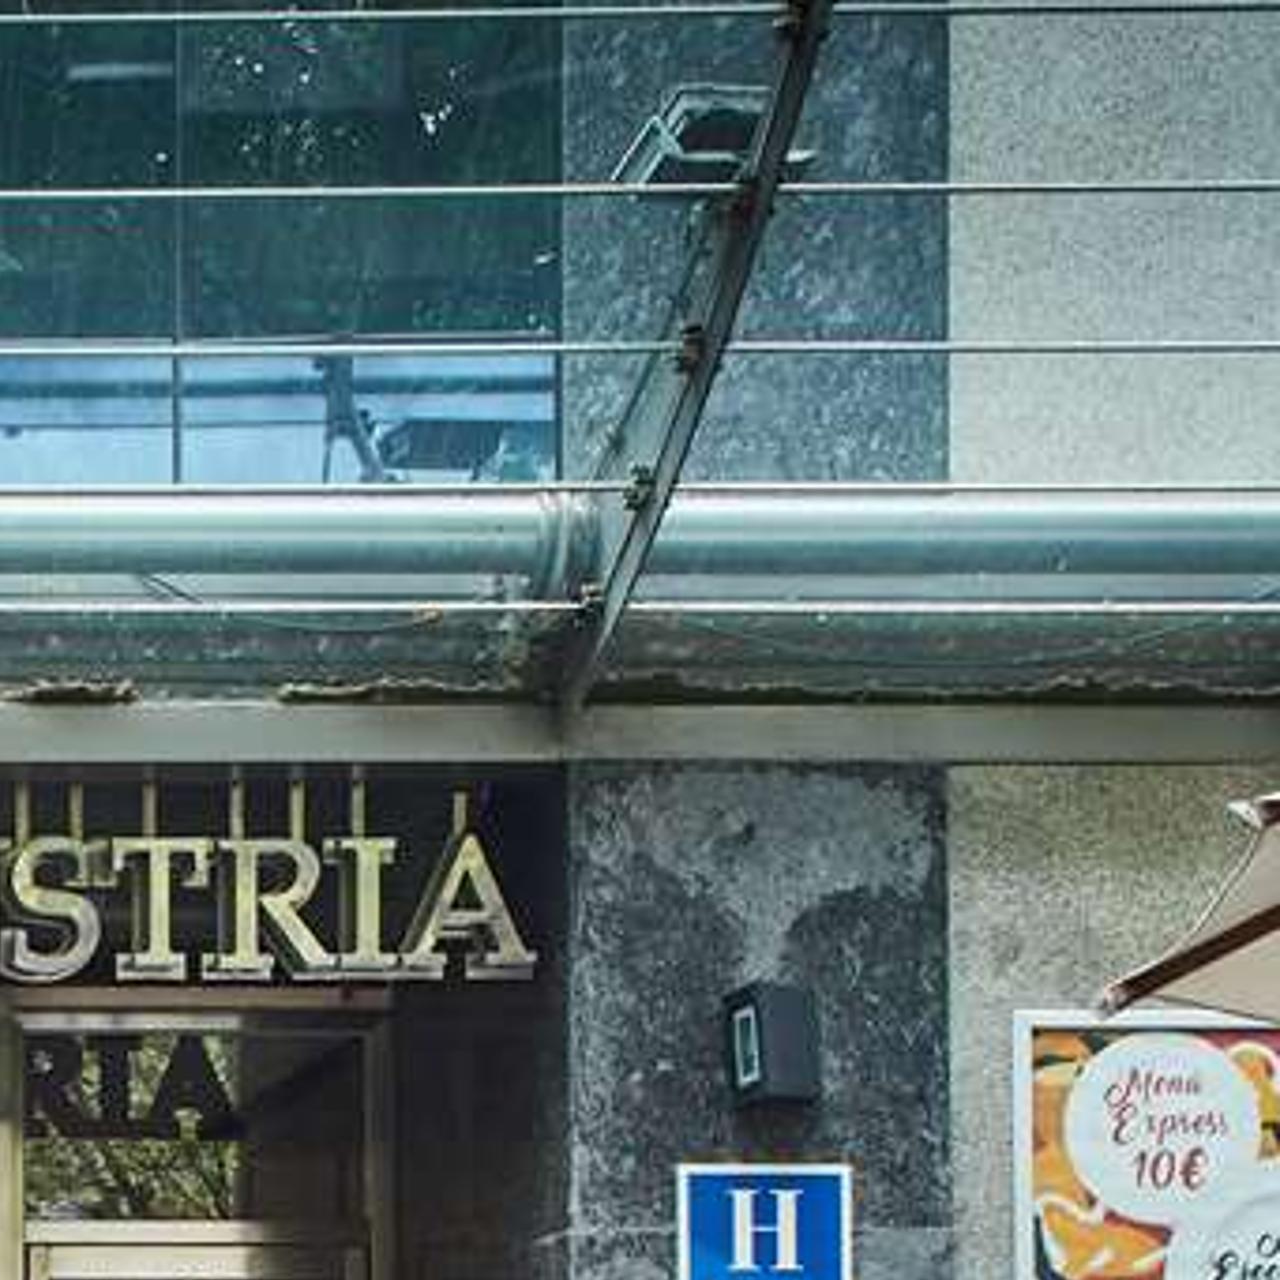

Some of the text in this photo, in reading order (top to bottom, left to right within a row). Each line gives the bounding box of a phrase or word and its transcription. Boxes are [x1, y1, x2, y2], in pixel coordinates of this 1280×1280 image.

[1113, 1103, 1229, 1146] Express
[1134, 1147, 1209, 1191] 10€
[726, 1188, 804, 1272] H
